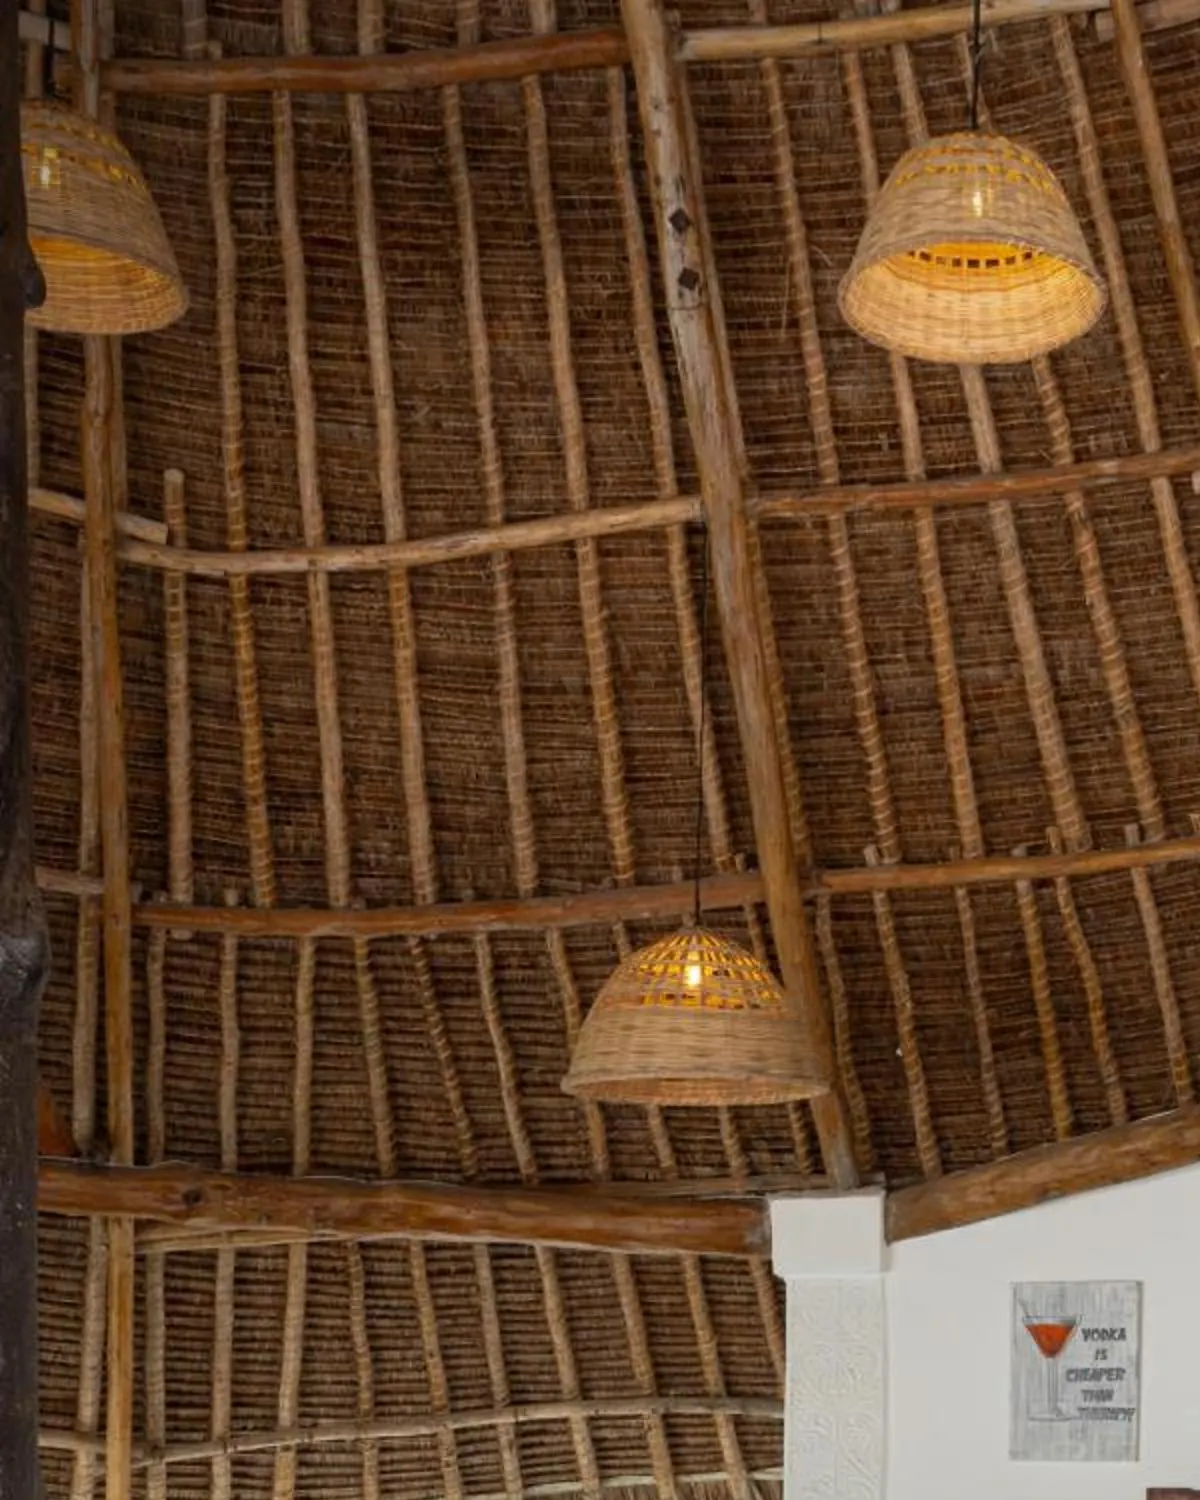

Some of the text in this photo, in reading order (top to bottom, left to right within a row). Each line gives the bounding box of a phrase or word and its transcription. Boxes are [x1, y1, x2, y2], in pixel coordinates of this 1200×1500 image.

[1081, 1327, 1127, 1342] VODKA
[1095, 1348, 1108, 1361] IS
[1065, 1367, 1126, 1383] CHEAPER
[1081, 1388, 1114, 1402] THAN
